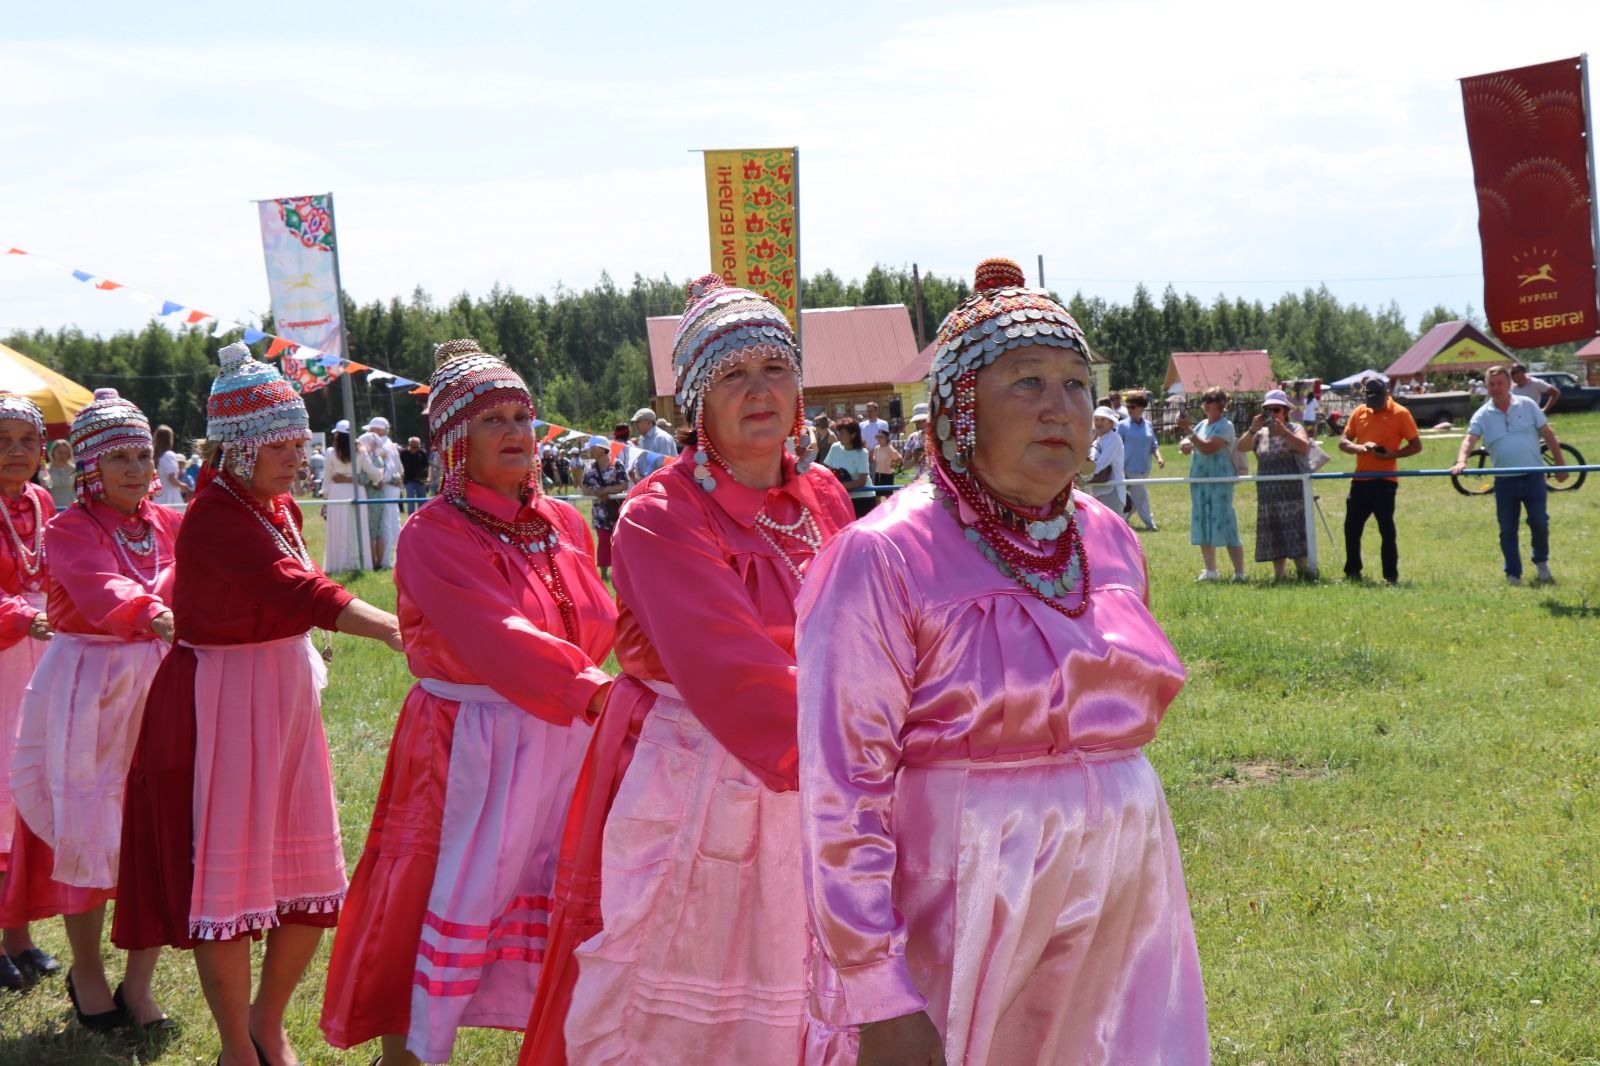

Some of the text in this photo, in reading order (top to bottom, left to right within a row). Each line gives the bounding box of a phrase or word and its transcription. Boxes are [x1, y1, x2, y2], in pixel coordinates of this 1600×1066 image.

[718, 166, 735, 235] БЕЛӘН!
[1519, 291, 1559, 304] НУРЛАТ
[1501, 311, 1584, 333] БЕЗ БЕРГӘ!
